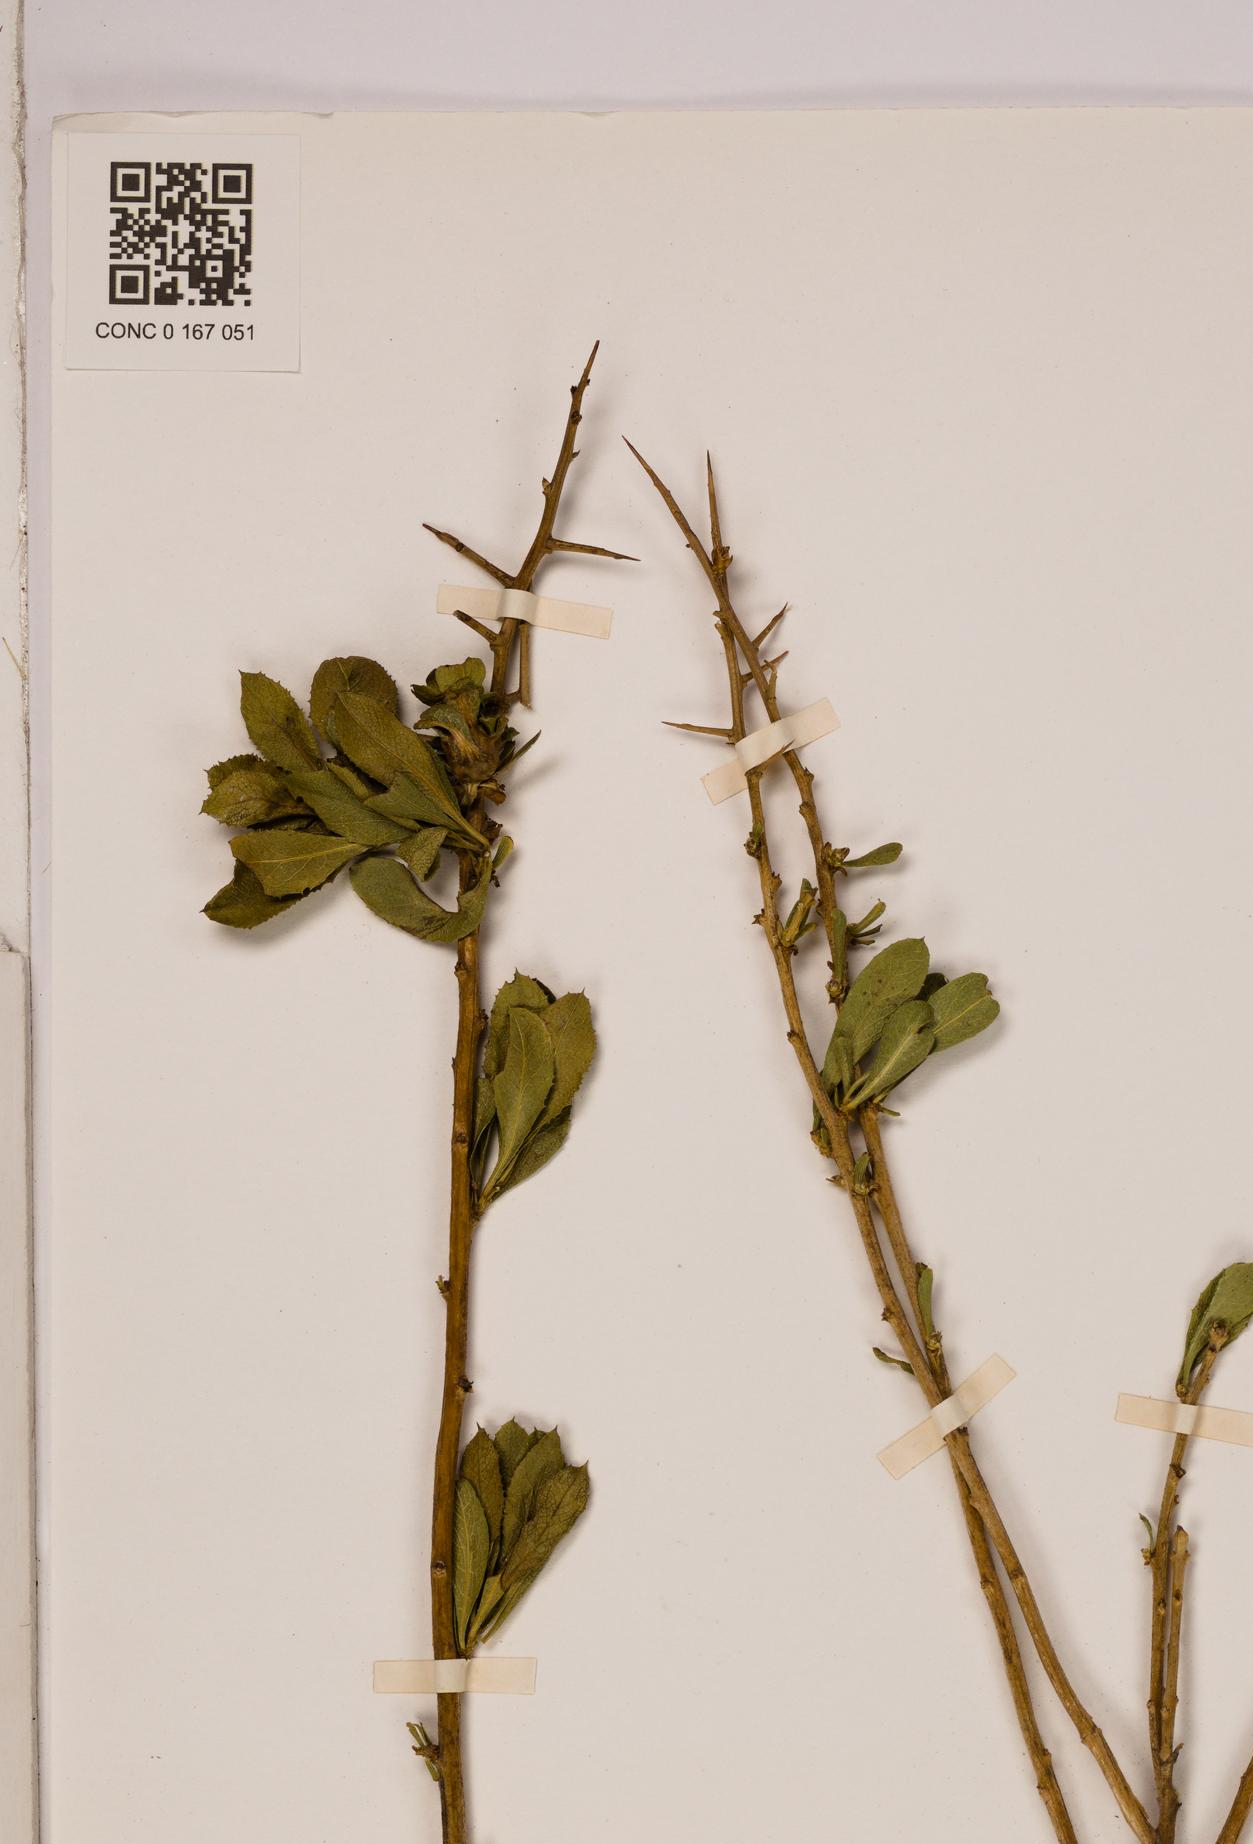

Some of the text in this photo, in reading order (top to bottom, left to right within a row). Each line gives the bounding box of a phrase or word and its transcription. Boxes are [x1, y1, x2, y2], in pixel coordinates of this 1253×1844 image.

[95, 321, 254, 341] CONC 0 167 051
